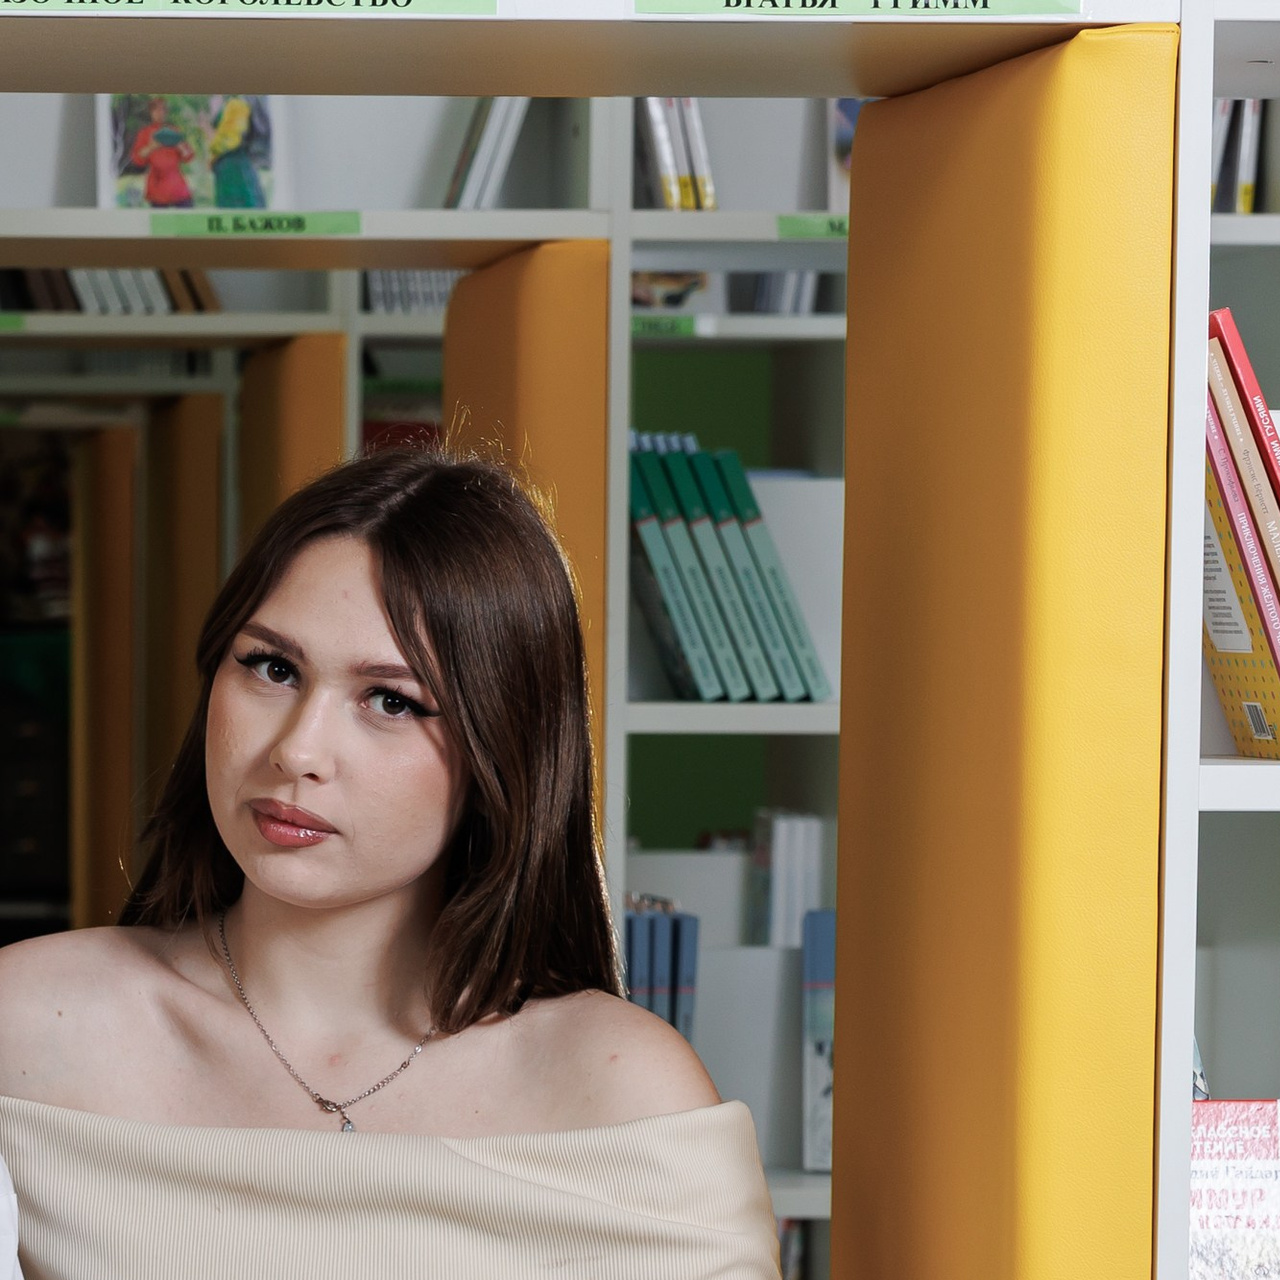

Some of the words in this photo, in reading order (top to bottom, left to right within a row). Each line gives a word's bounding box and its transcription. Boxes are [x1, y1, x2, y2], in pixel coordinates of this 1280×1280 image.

[232, 215, 307, 233] БАЖОВ
[1253, 396, 1275, 437] ГУСЯМИ
[1237, 512, 1266, 586] ПРИКЛЮЧЕНИЯ
[1191, 1140, 1245, 1154] ТЕНИЕ
